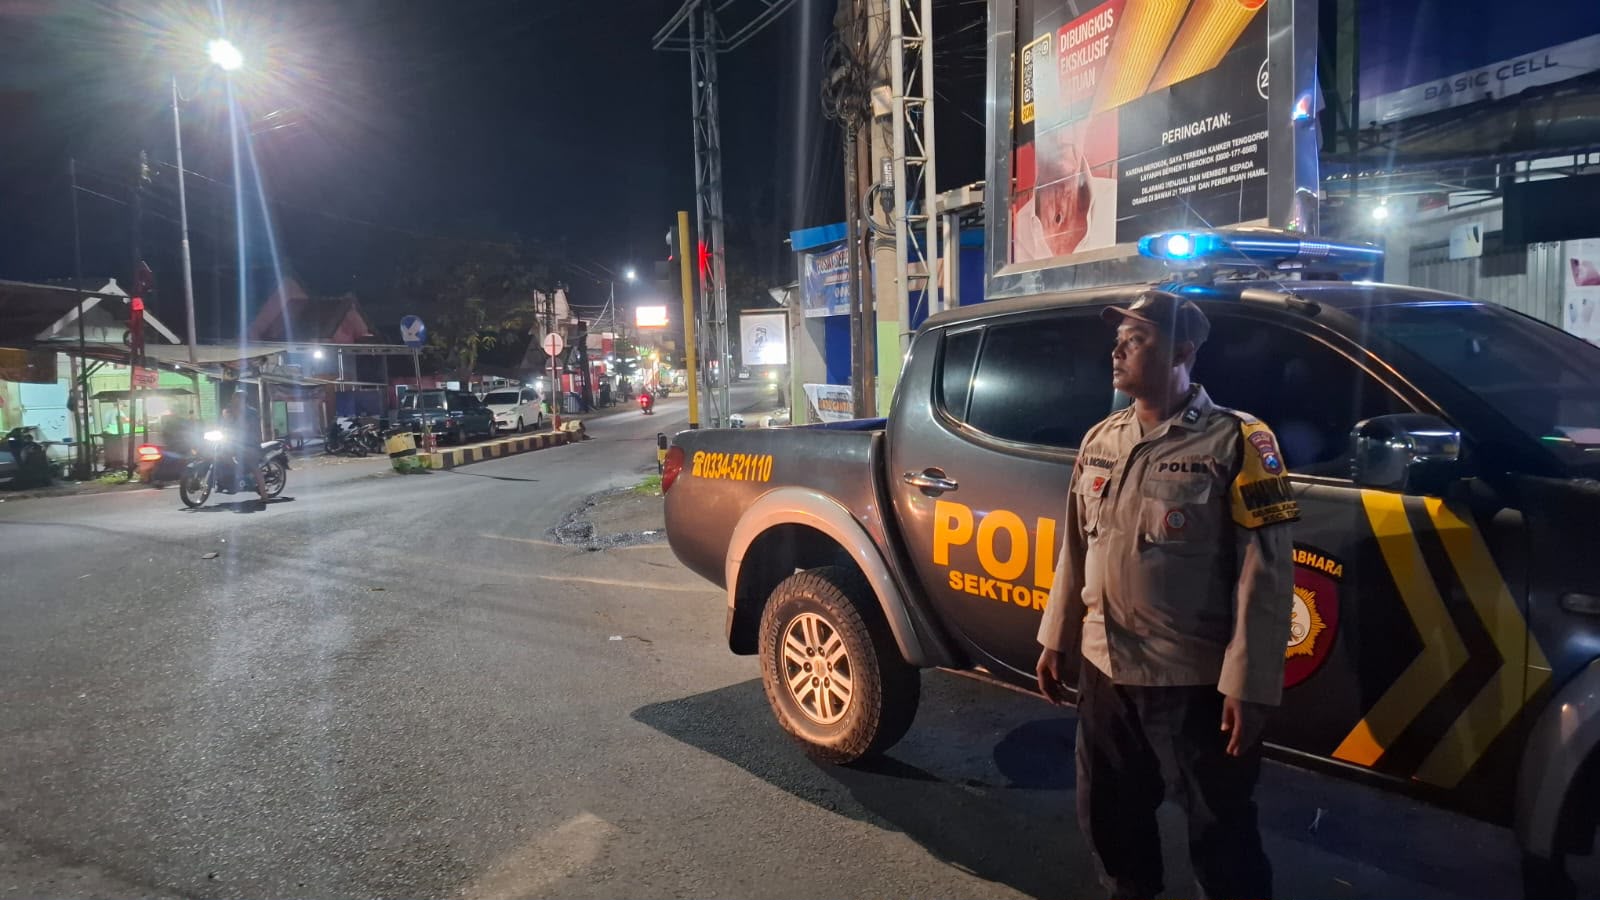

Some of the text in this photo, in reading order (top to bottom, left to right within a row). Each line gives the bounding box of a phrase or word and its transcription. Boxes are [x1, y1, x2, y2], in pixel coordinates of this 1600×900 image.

[1060, 8, 1114, 53] DIBUNGKUS
[1061, 35, 1110, 76] EKSKLUSIF
[1424, 54, 1559, 101] BASIC CELL
[1161, 111, 1232, 145] PERINGATAN:
[1182, 148, 1207, 161] TERKENA
[1207, 140, 1232, 154] KANKER
[1178, 184, 1196, 195] TAHUN
[1198, 180, 1210, 191] DAN
[1210, 172, 1247, 187] PEREMPUAN
[1189, 174, 1201, 183] DAN
[1201, 167, 1228, 181] MEMBERI
[1229, 159, 1254, 173] KEPADA
[703, 452, 773, 482] 0334-521110
[948, 570, 1050, 612] SEKTOR
